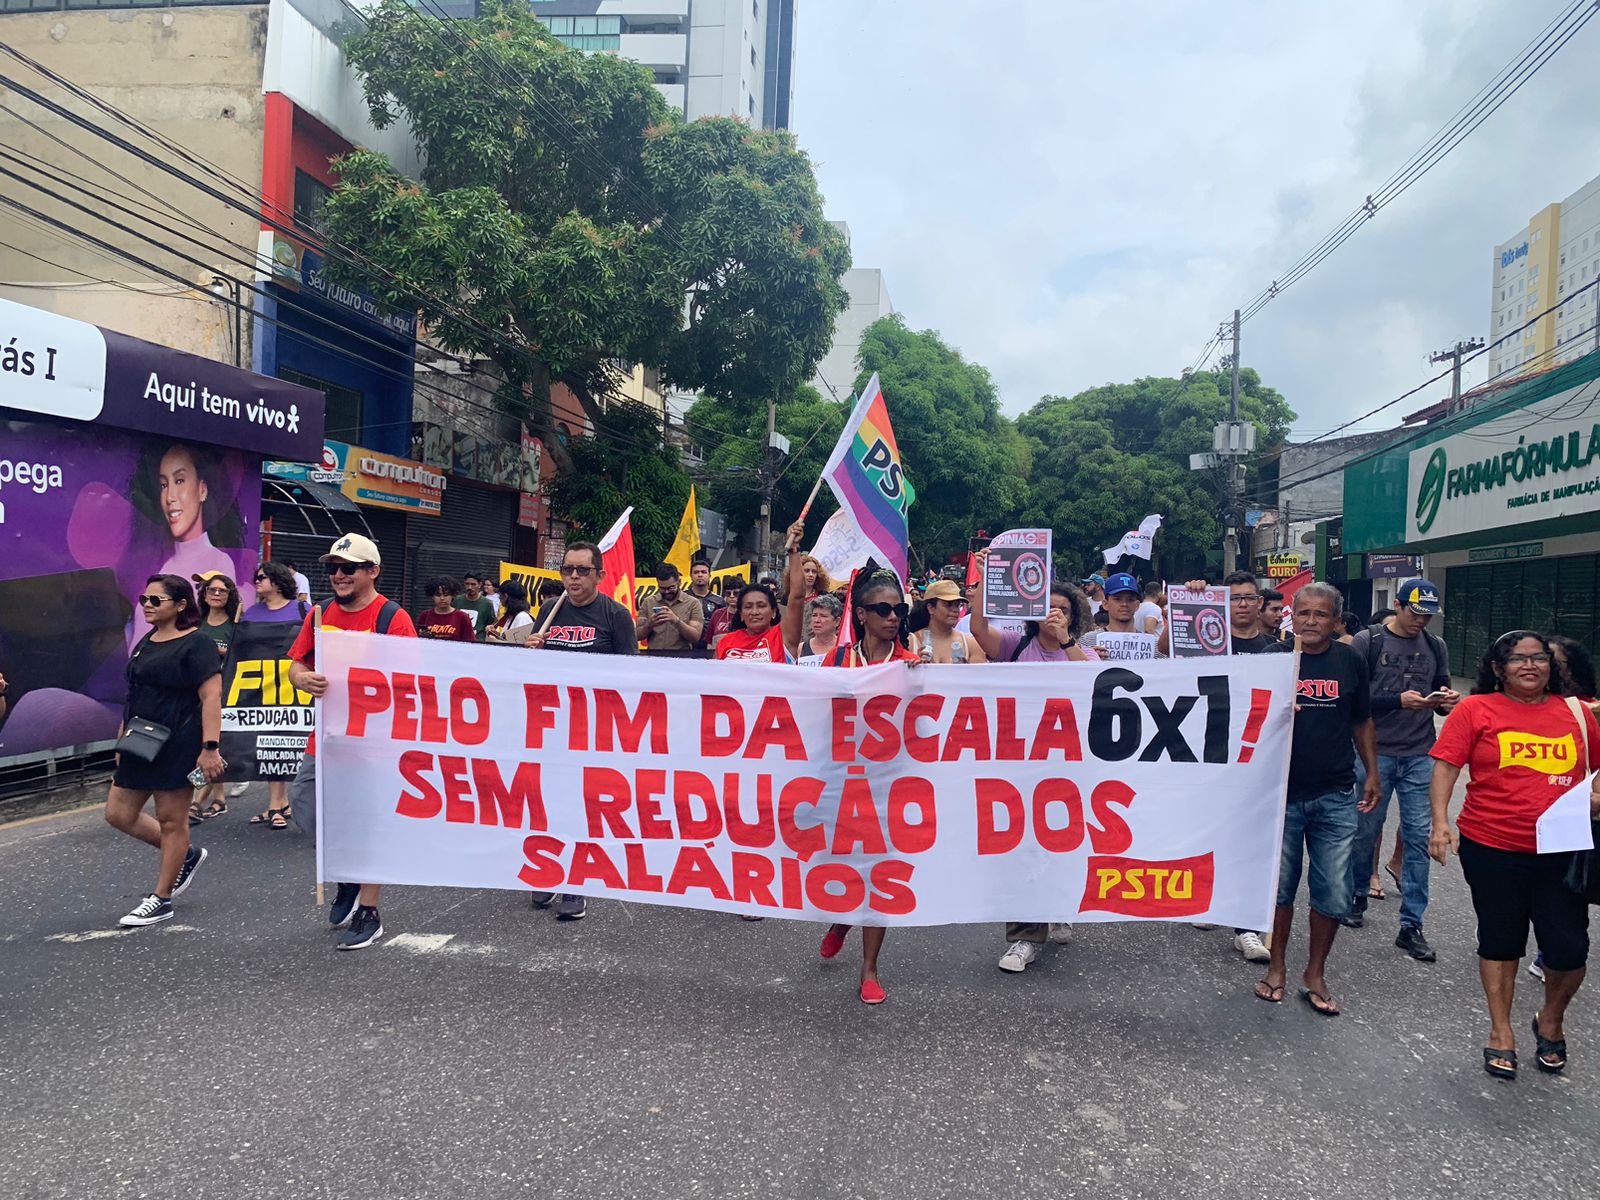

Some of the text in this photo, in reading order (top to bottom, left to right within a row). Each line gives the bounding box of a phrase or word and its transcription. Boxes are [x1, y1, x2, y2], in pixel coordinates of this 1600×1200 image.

[308, 269, 325, 291] Seu
[0, 337, 57, 381] ás I
[143, 372, 286, 430] Aqui tem vivo
[1447, 424, 1600, 499] FARMAFÓRMULA
[0, 459, 62, 494] pega
[1541, 490, 1550, 502] DE
[1553, 476, 1600, 501] MANIPULAÇÃ
[1270, 567, 1298, 577] OURO
[549, 626, 596, 642] PSTU
[1100, 640, 1152, 652] PELO FIM DA
[238, 707, 298, 727] REDUÇÃO
[346, 667, 490, 745] PELO
[523, 683, 669, 755] FIM
[700, 694, 808, 761] DA
[832, 694, 1083, 763] ESCALA
[257, 750, 295, 761] BANCADA
[259, 738, 295, 747] MANDATO
[1510, 742, 1568, 761] PSTU
[395, 750, 1137, 862] SEM REDUÇÃO DOS
[517, 834, 918, 915] SALÁRIOS
[1096, 868, 1193, 899] PSTU
